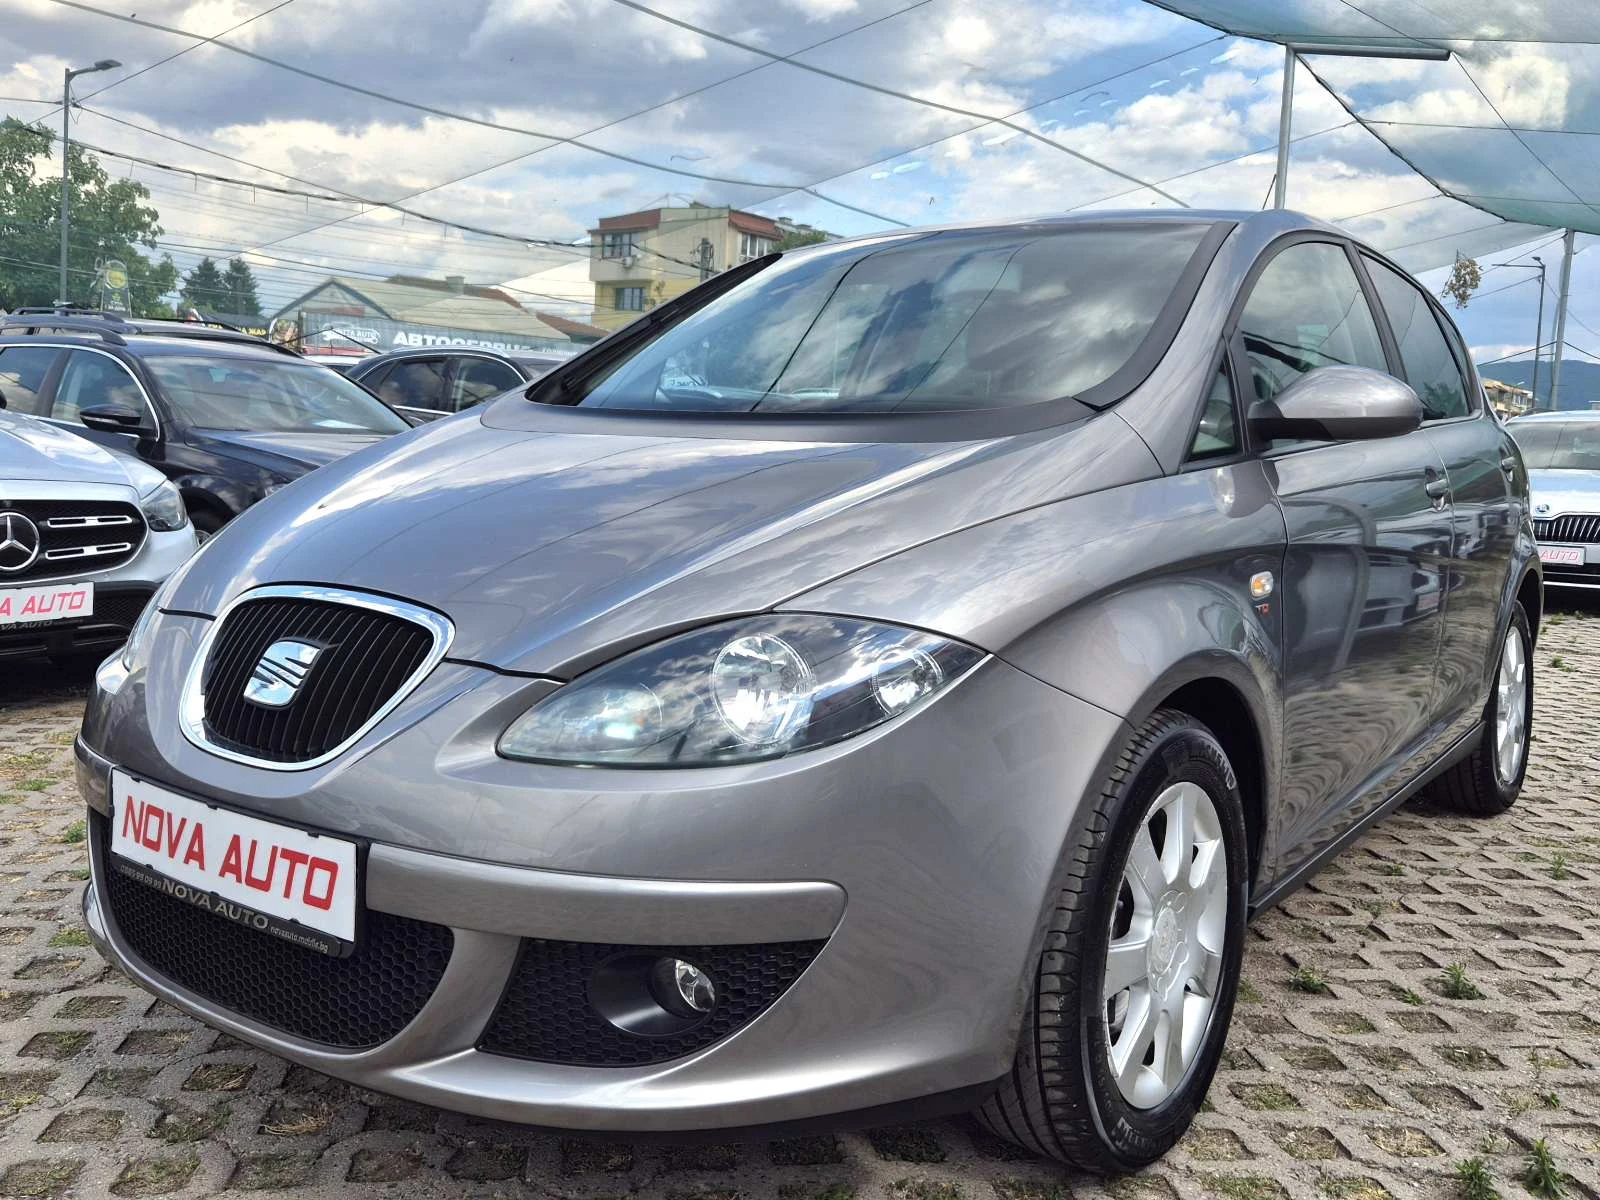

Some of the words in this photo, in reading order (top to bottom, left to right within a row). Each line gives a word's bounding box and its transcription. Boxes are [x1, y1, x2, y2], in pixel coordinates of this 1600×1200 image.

[1540, 550, 1579, 561] AUTO
[20, 591, 86, 615] AUTO
[121, 794, 206, 871] NOVA
[218, 833, 339, 911] AUTO
[162, 878, 212, 909] NOVA
[214, 901, 269, 929] AUTO
